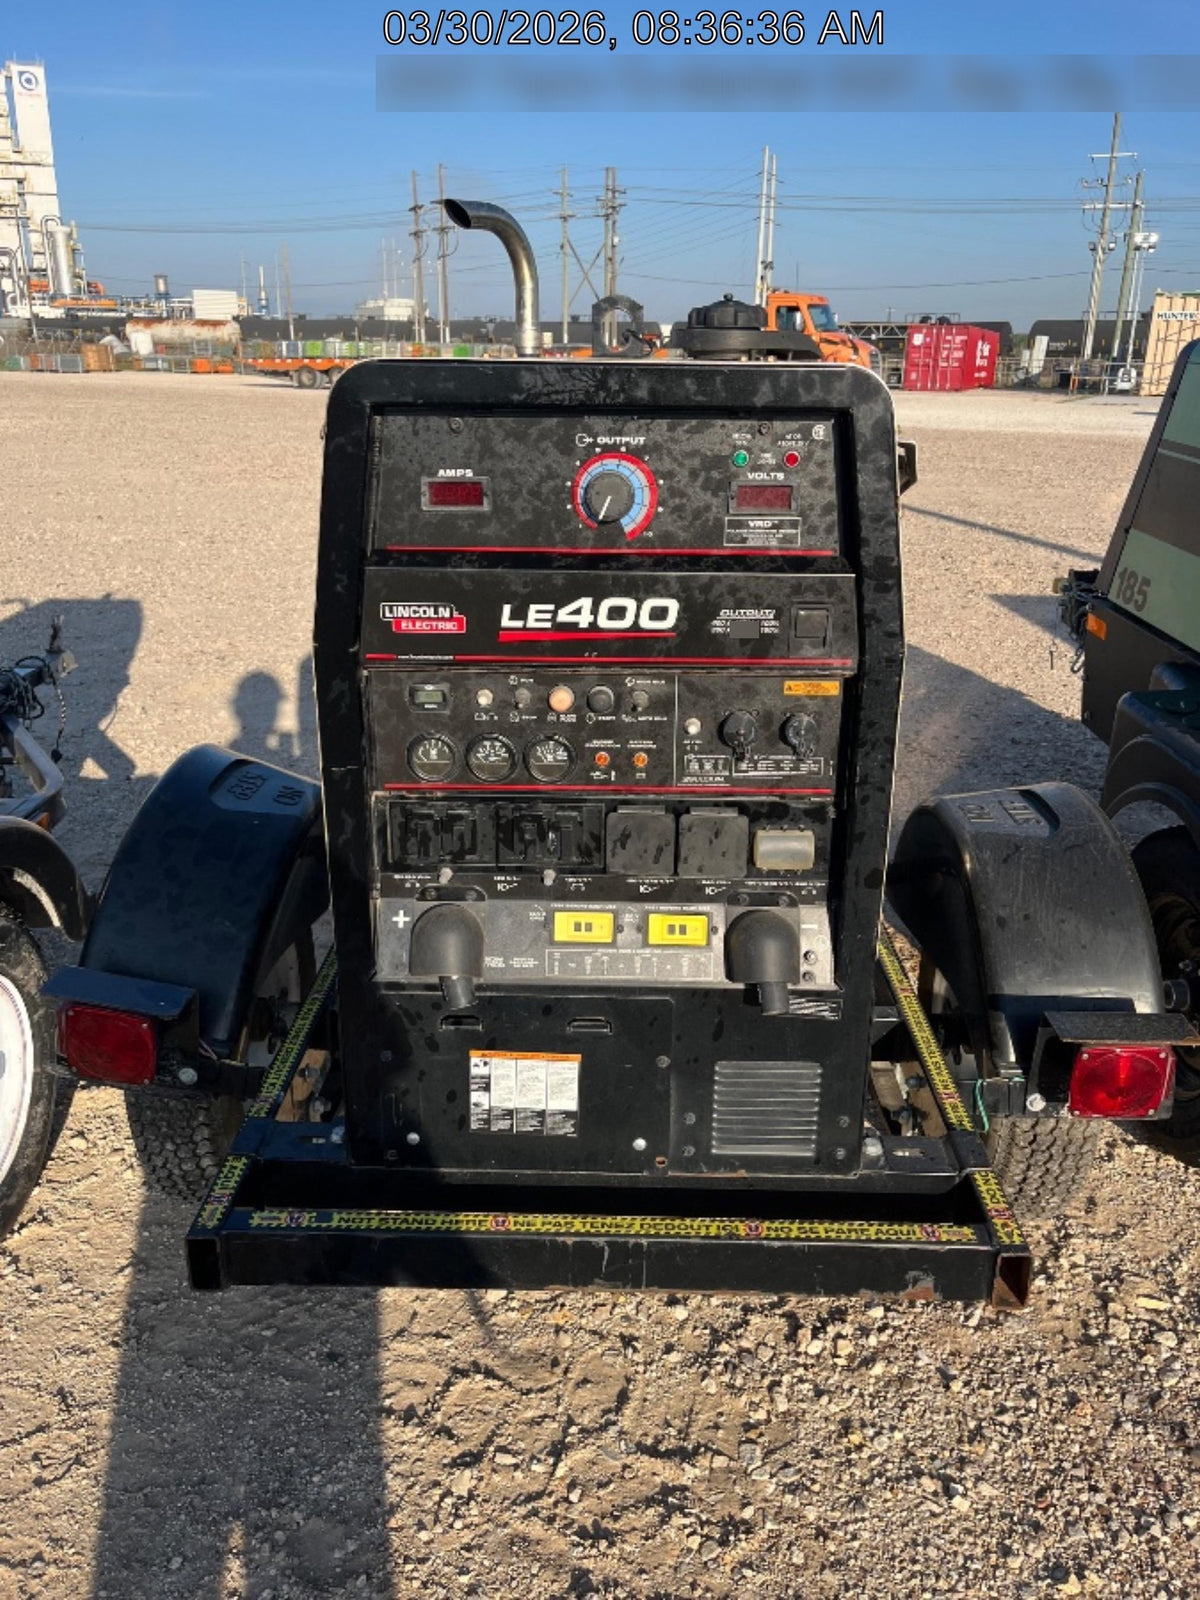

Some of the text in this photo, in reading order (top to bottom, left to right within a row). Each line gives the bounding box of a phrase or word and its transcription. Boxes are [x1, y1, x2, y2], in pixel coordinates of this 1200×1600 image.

[597, 436, 646, 445] OUTPUT
[437, 469, 473, 477] AMPS
[747, 472, 785, 480] VOLTS
[1115, 567, 1151, 613] 185
[385, 606, 451, 618] LINCOLN
[500, 596, 680, 629] LE400
[401, 620, 459, 631] ELECTRIC
[380, 1217, 437, 1226] STAND
[513, 1219, 537, 1228] NE
[766, 1225, 793, 1234] NO
[876, 1227, 917, 1237] AQUI
